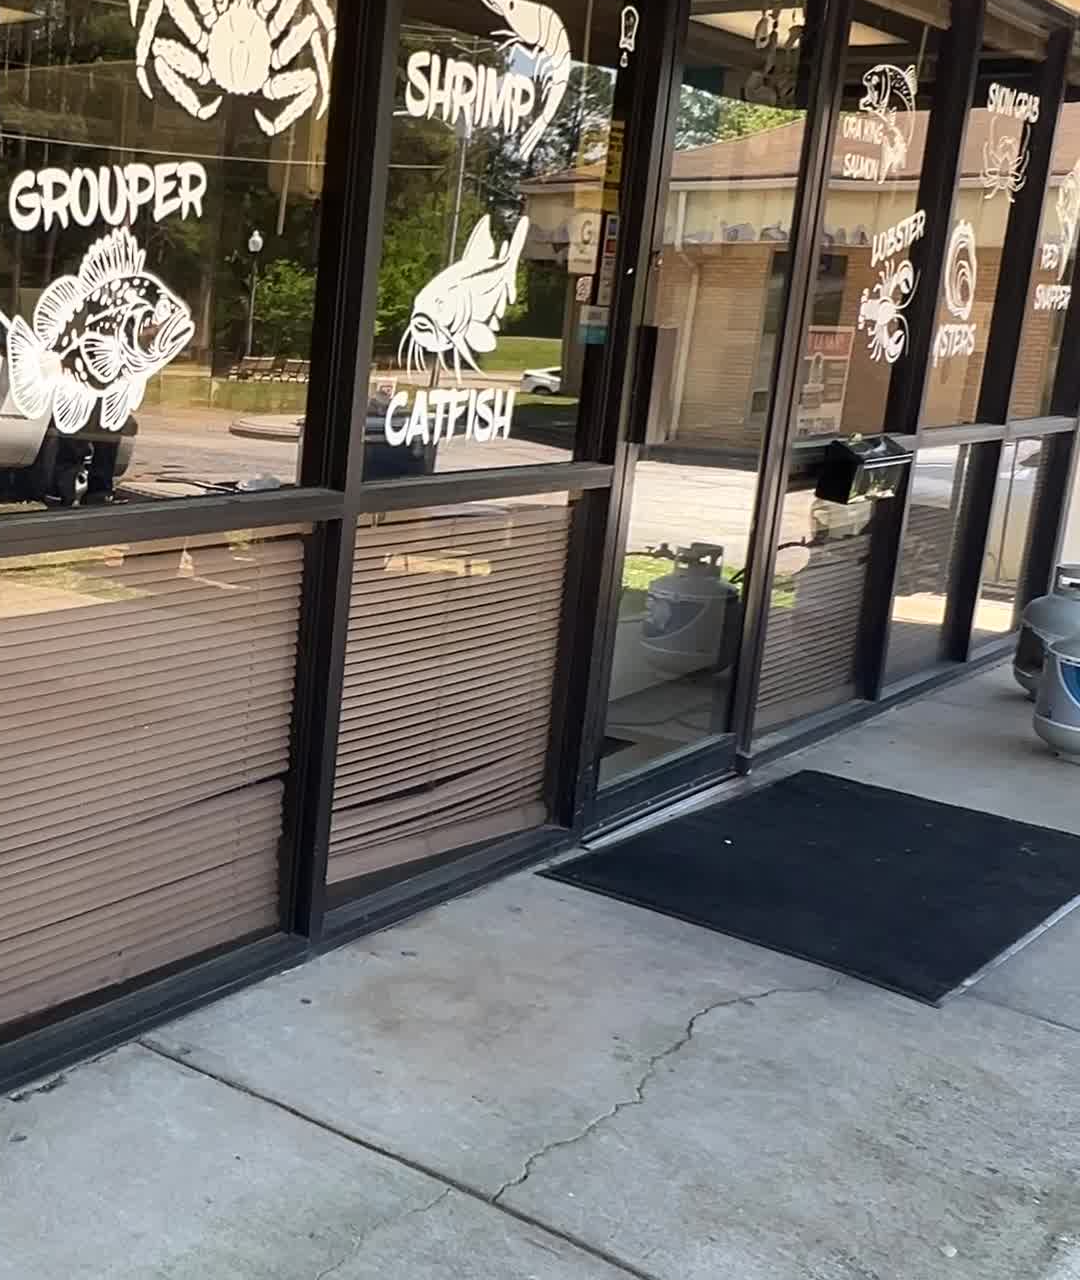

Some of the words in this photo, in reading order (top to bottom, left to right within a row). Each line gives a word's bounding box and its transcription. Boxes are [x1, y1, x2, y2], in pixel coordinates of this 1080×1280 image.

[405, 50, 536, 138] SHRIMP
[8, 161, 208, 232] GROUPER
[871, 209, 926, 268] LOBSTER
[385, 388, 516, 447] CATFISH
